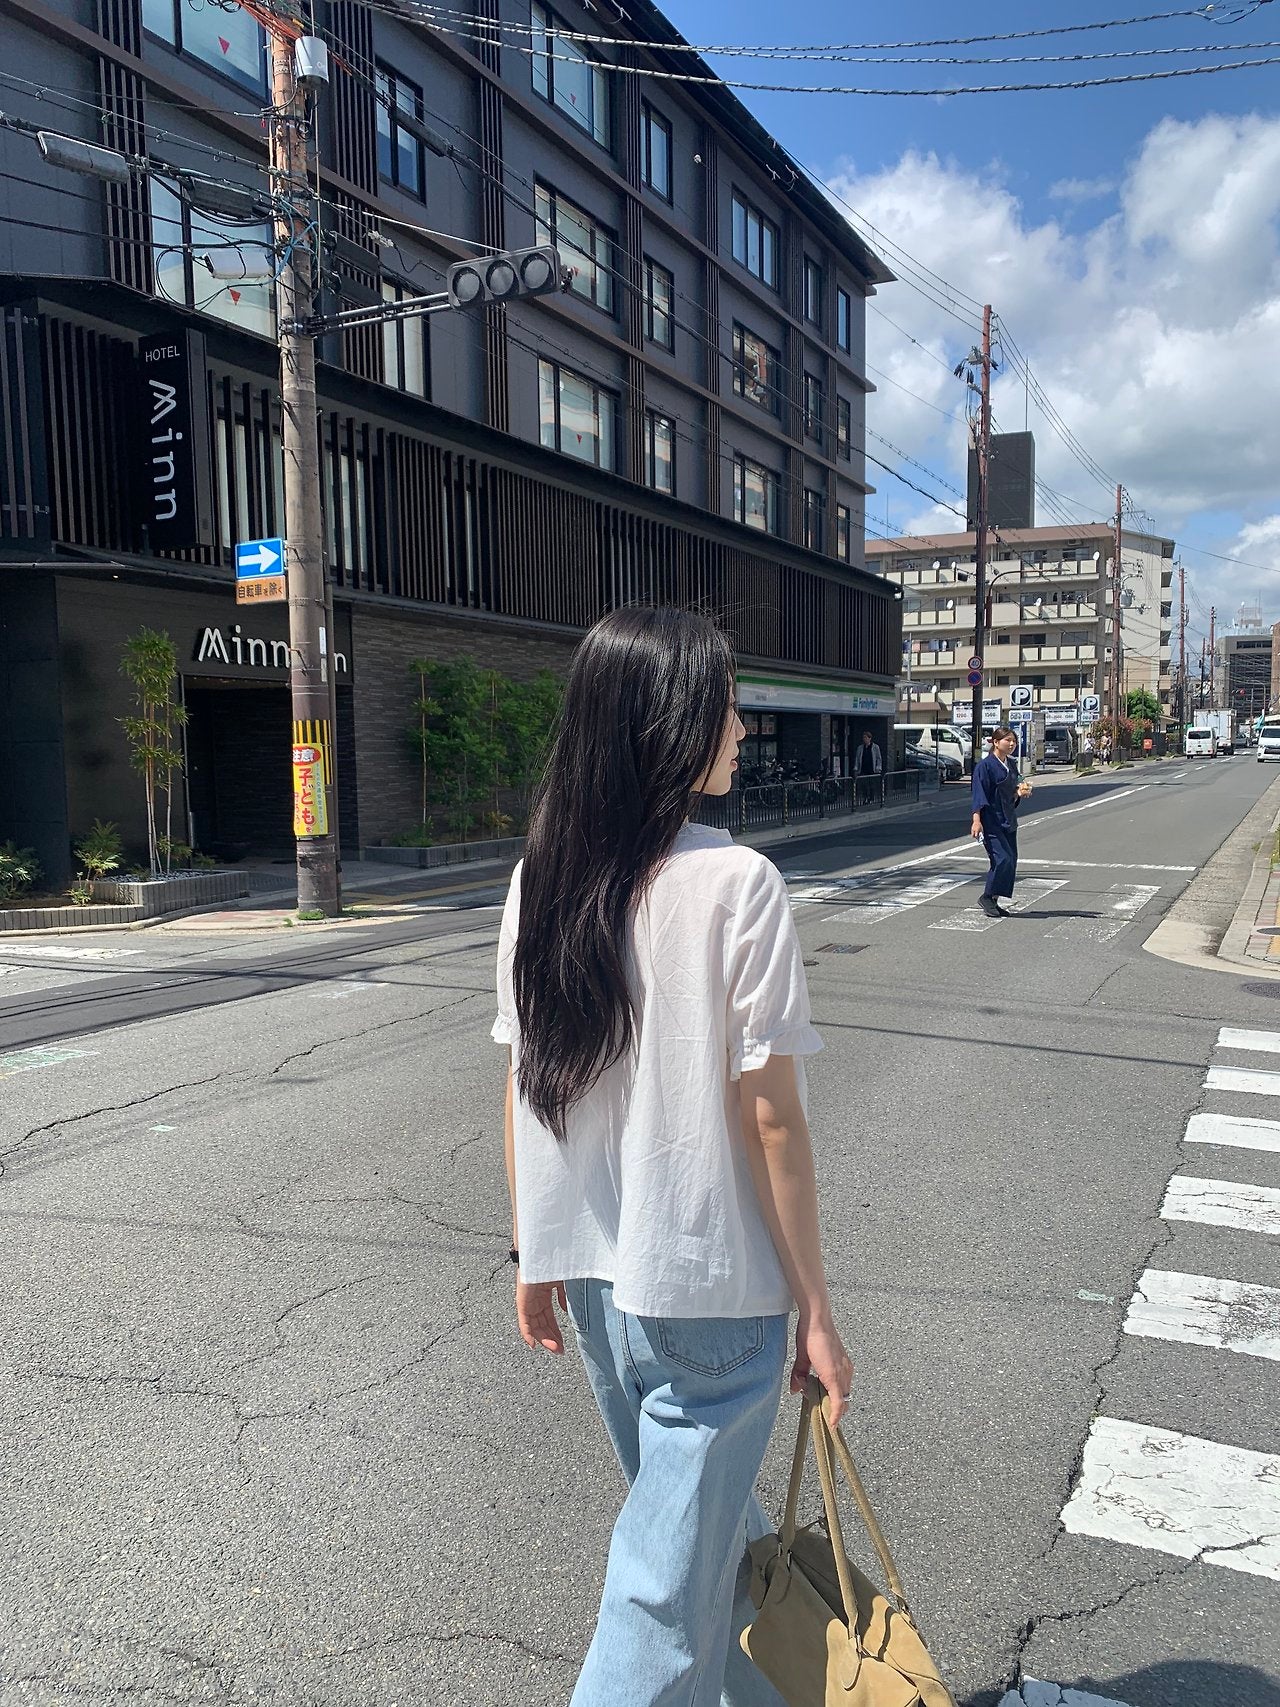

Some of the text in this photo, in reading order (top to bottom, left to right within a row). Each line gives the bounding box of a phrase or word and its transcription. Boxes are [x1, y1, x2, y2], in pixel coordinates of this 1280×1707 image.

[145, 345, 181, 363] HOTEL
[148, 379, 183, 520] Minn
[238, 582, 283, 599] 自転車を除く
[1015, 688, 1030, 704] P
[1086, 697, 1097, 709] P
